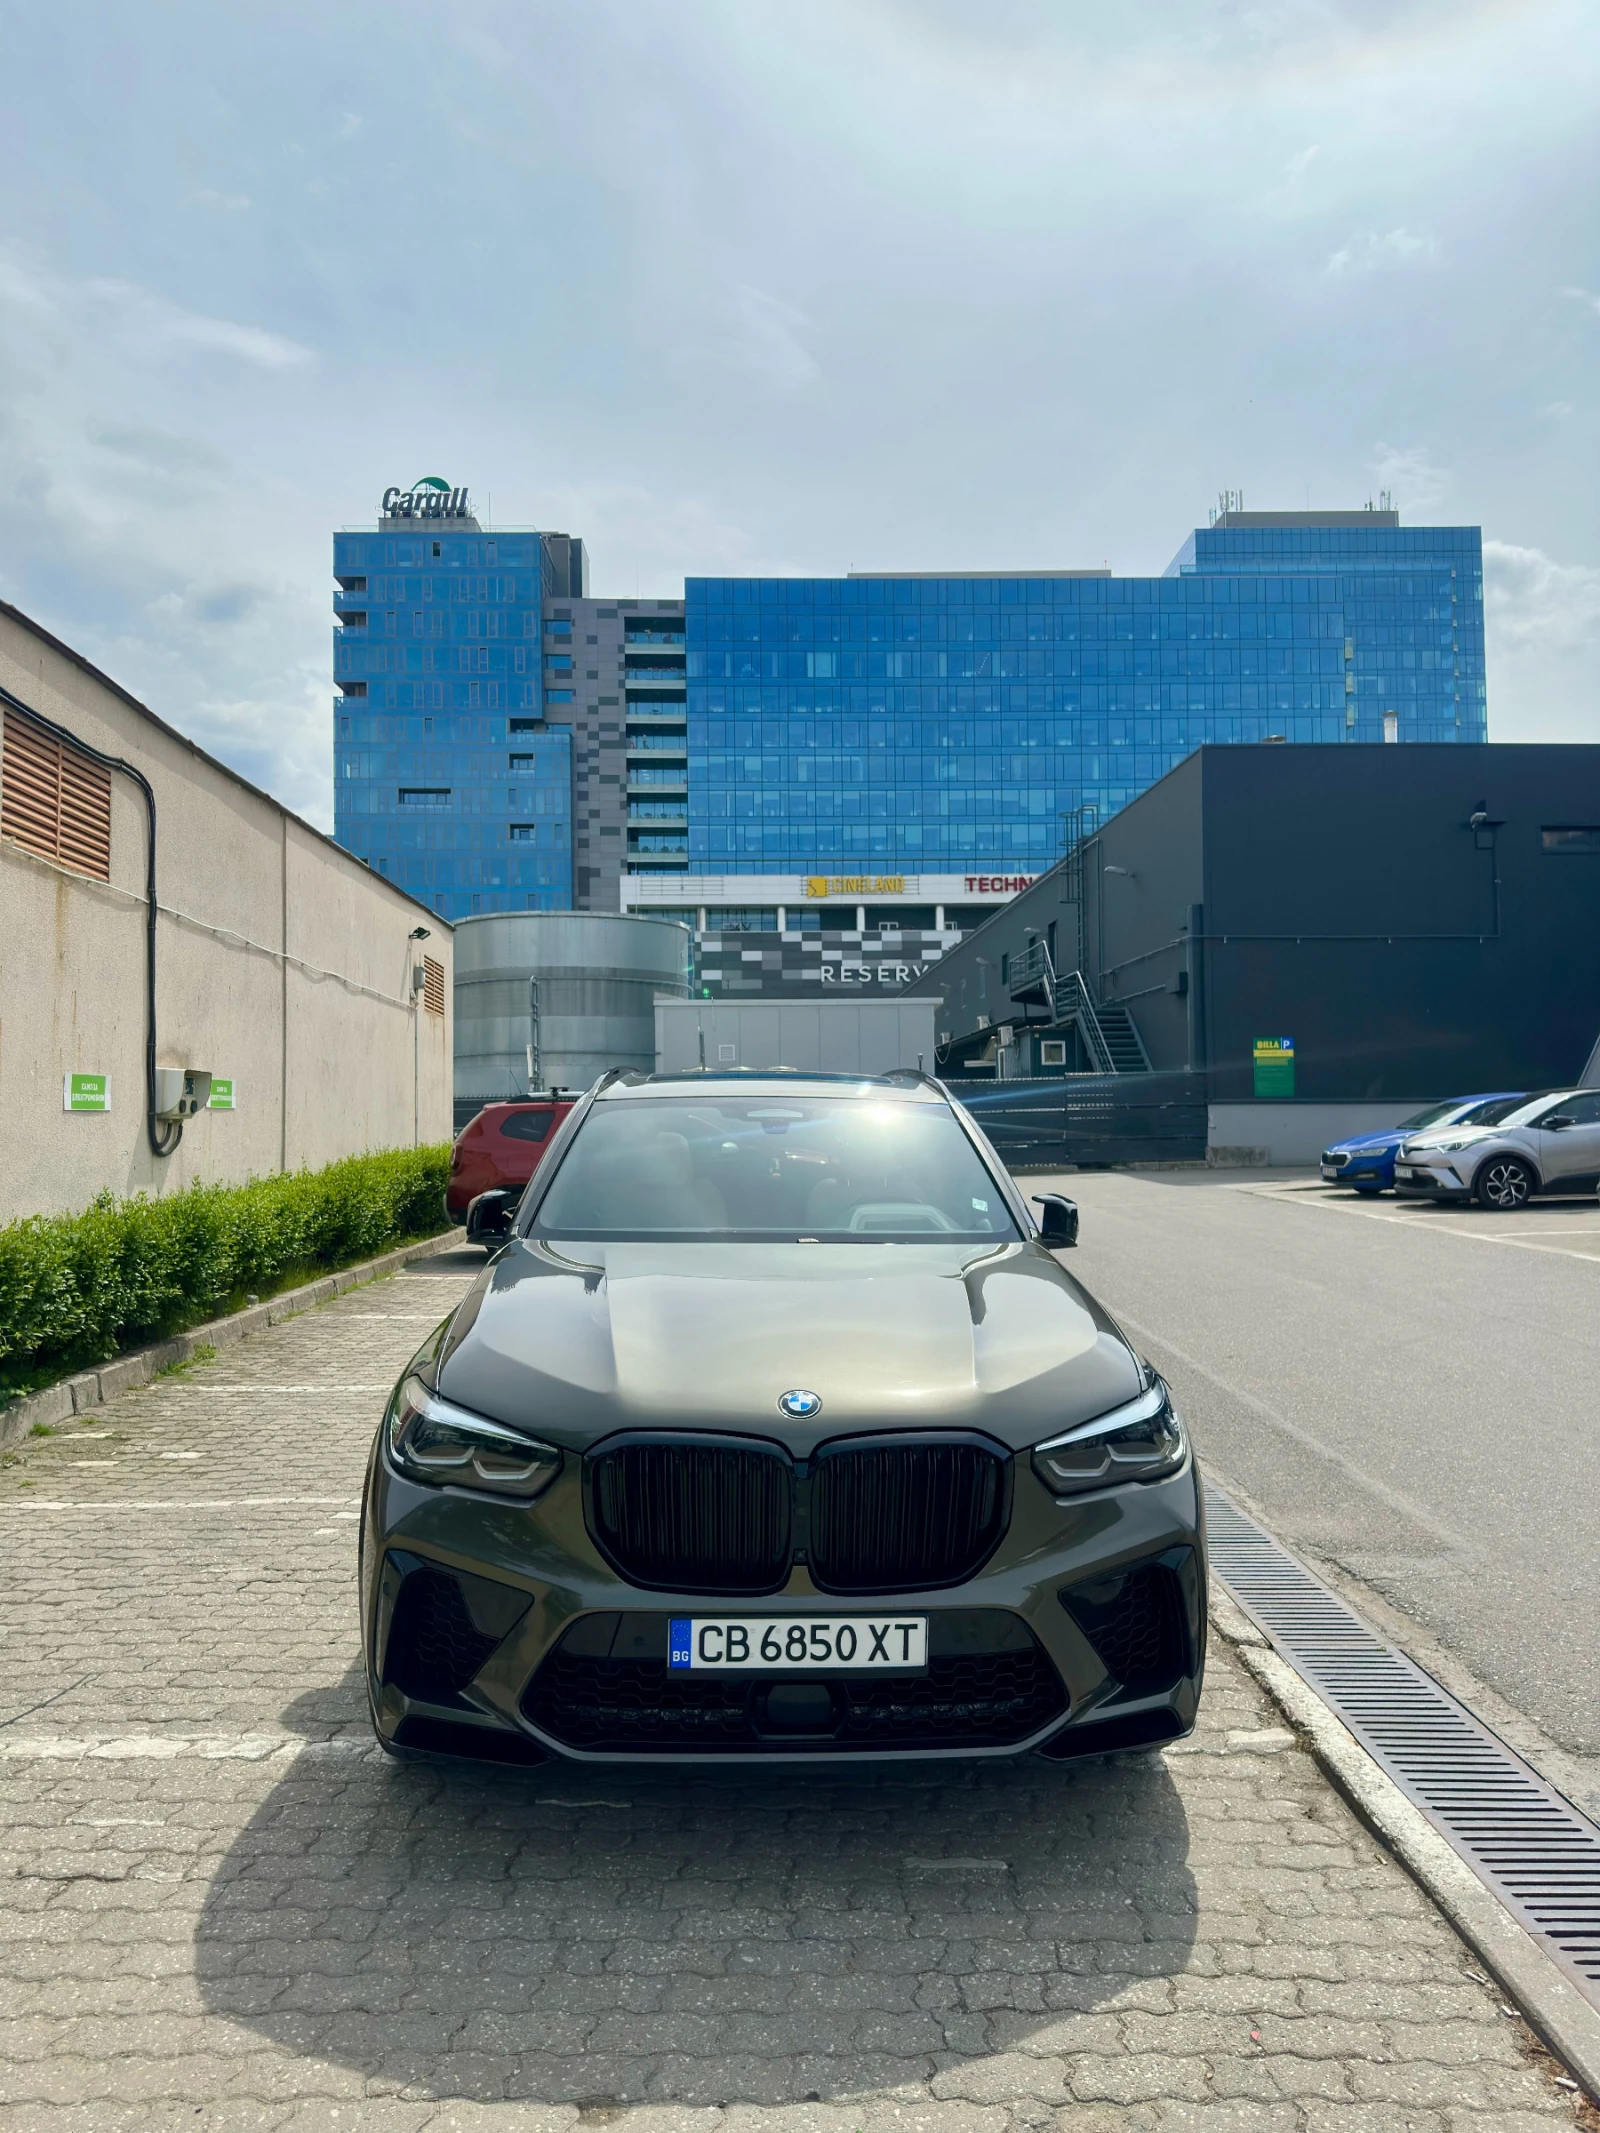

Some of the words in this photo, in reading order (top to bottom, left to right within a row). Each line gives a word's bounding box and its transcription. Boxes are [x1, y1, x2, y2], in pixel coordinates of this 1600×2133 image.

[382, 487, 468, 517] Cargill
[832, 876, 905, 893] CINELAND
[1257, 1041, 1280, 1049] BILLA
[1283, 1040, 1291, 1049] P
[699, 1625, 750, 1662] CB
[760, 1624, 858, 1662] 6850
[868, 1624, 918, 1661] XT
[672, 1650, 689, 1662] BG
